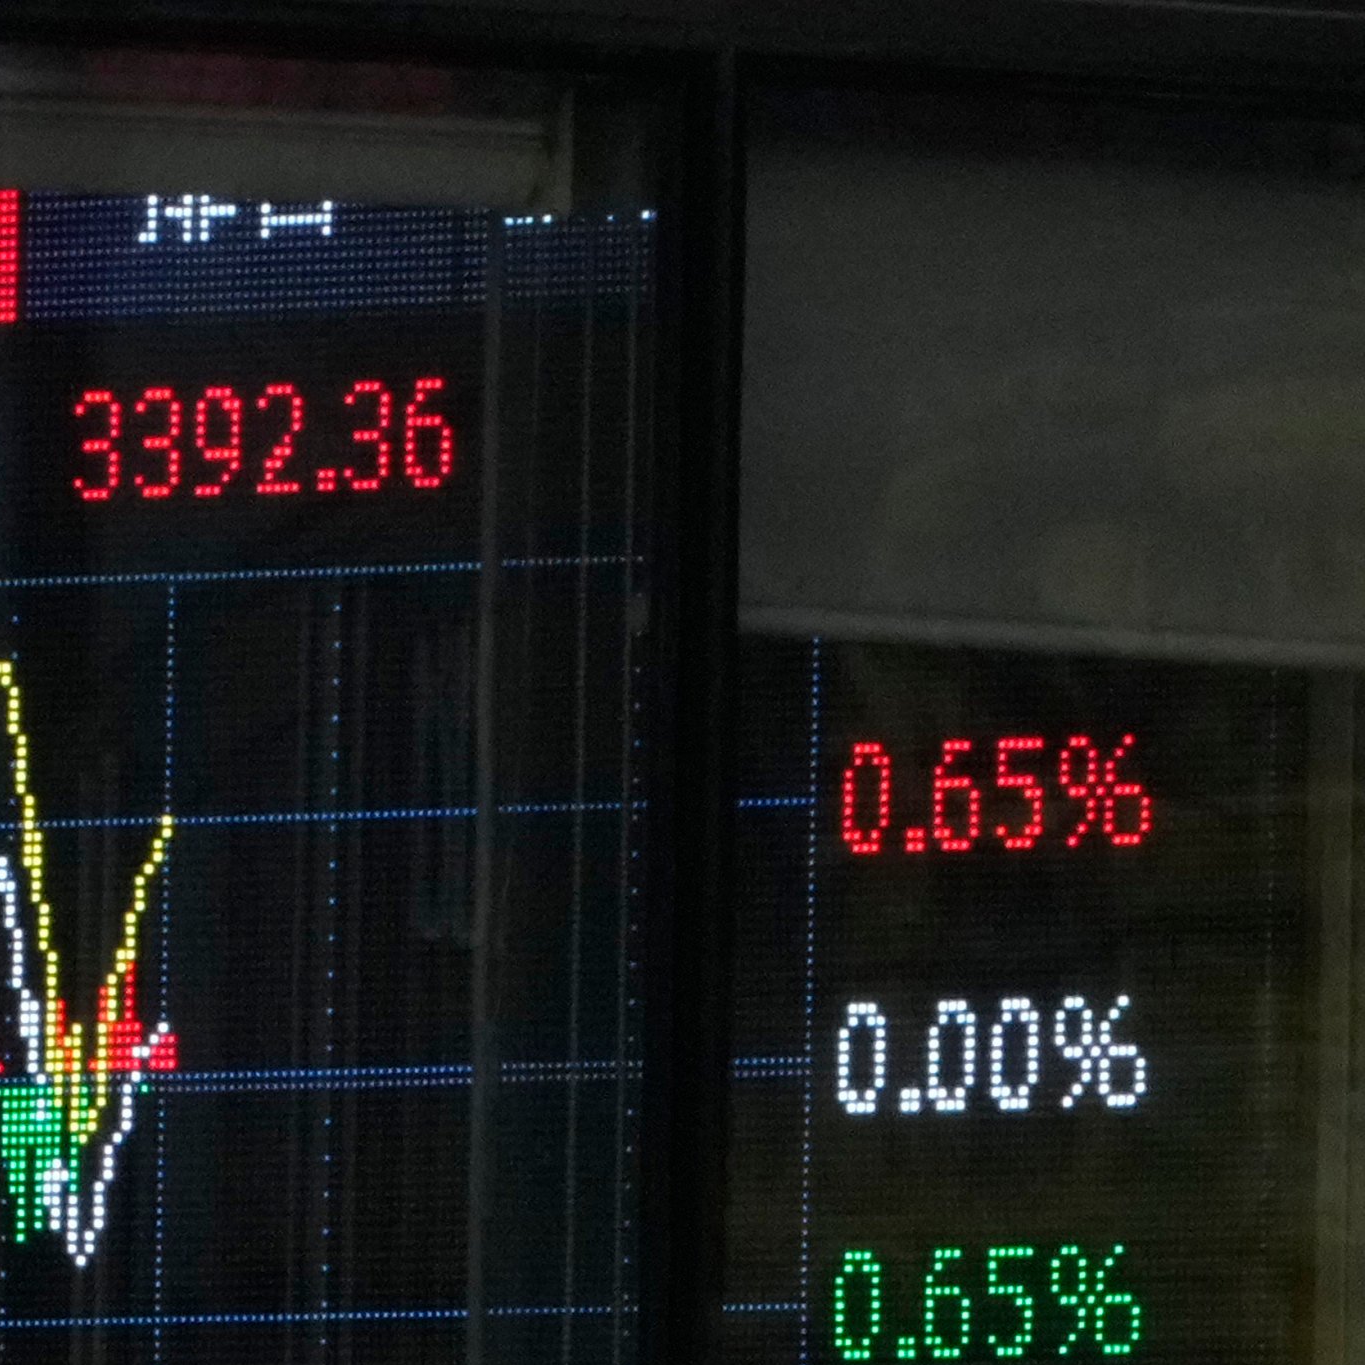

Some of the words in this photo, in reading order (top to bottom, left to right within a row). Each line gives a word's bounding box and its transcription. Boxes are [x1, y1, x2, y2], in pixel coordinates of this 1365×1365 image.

[73, 377, 453, 500] 3392.36
[841, 735, 1153, 855] 0.65%
[837, 994, 1147, 1114] 0.00%
[833, 1245, 1141, 1360] 0.65%
